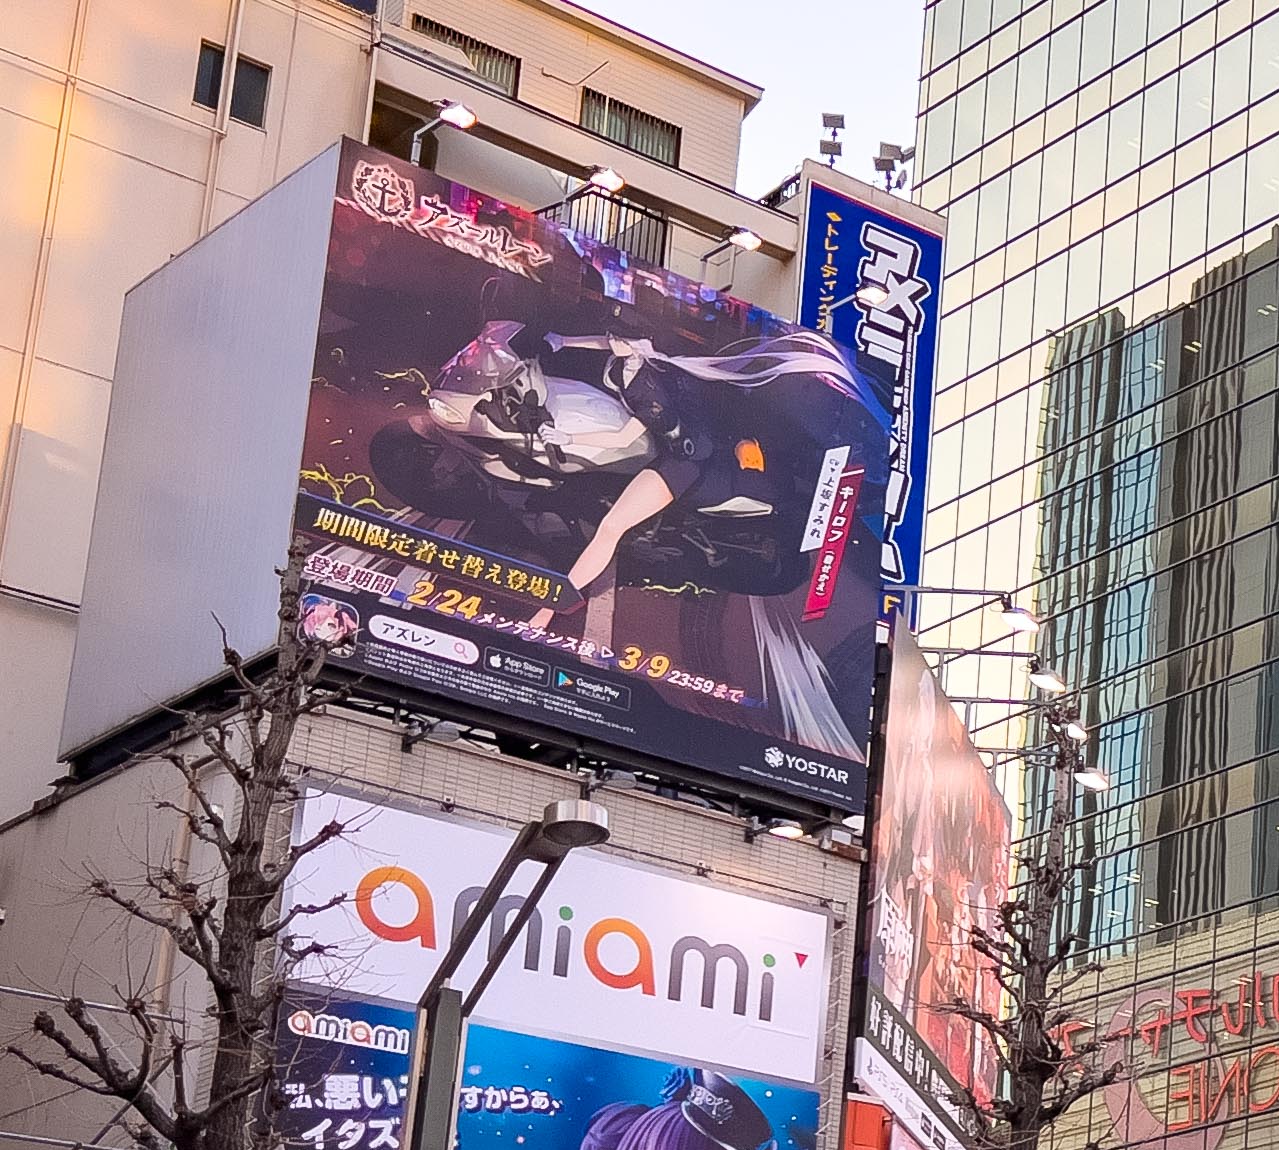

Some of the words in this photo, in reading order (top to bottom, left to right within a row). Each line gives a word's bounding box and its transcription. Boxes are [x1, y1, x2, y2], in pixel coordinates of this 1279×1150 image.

[419, 197, 553, 266] アズールレーン
[827, 486, 854, 542] キーロフ
[313, 507, 563, 603] 期間限定着せ替え登場!
[304, 555, 399, 598] 登場期間
[406, 579, 483, 622] 2/24
[618, 645, 671, 679] 3/9
[381, 621, 436, 647] アズレン
[505, 656, 522, 671] App
[576, 677, 604, 692] Google
[604, 684, 621, 699] Play
[785, 755, 849, 785] YOSTAR
[355, 864, 776, 1023] amiami
[289, 1010, 409, 1054] amiami
[301, 1117, 400, 1150] イタズ
